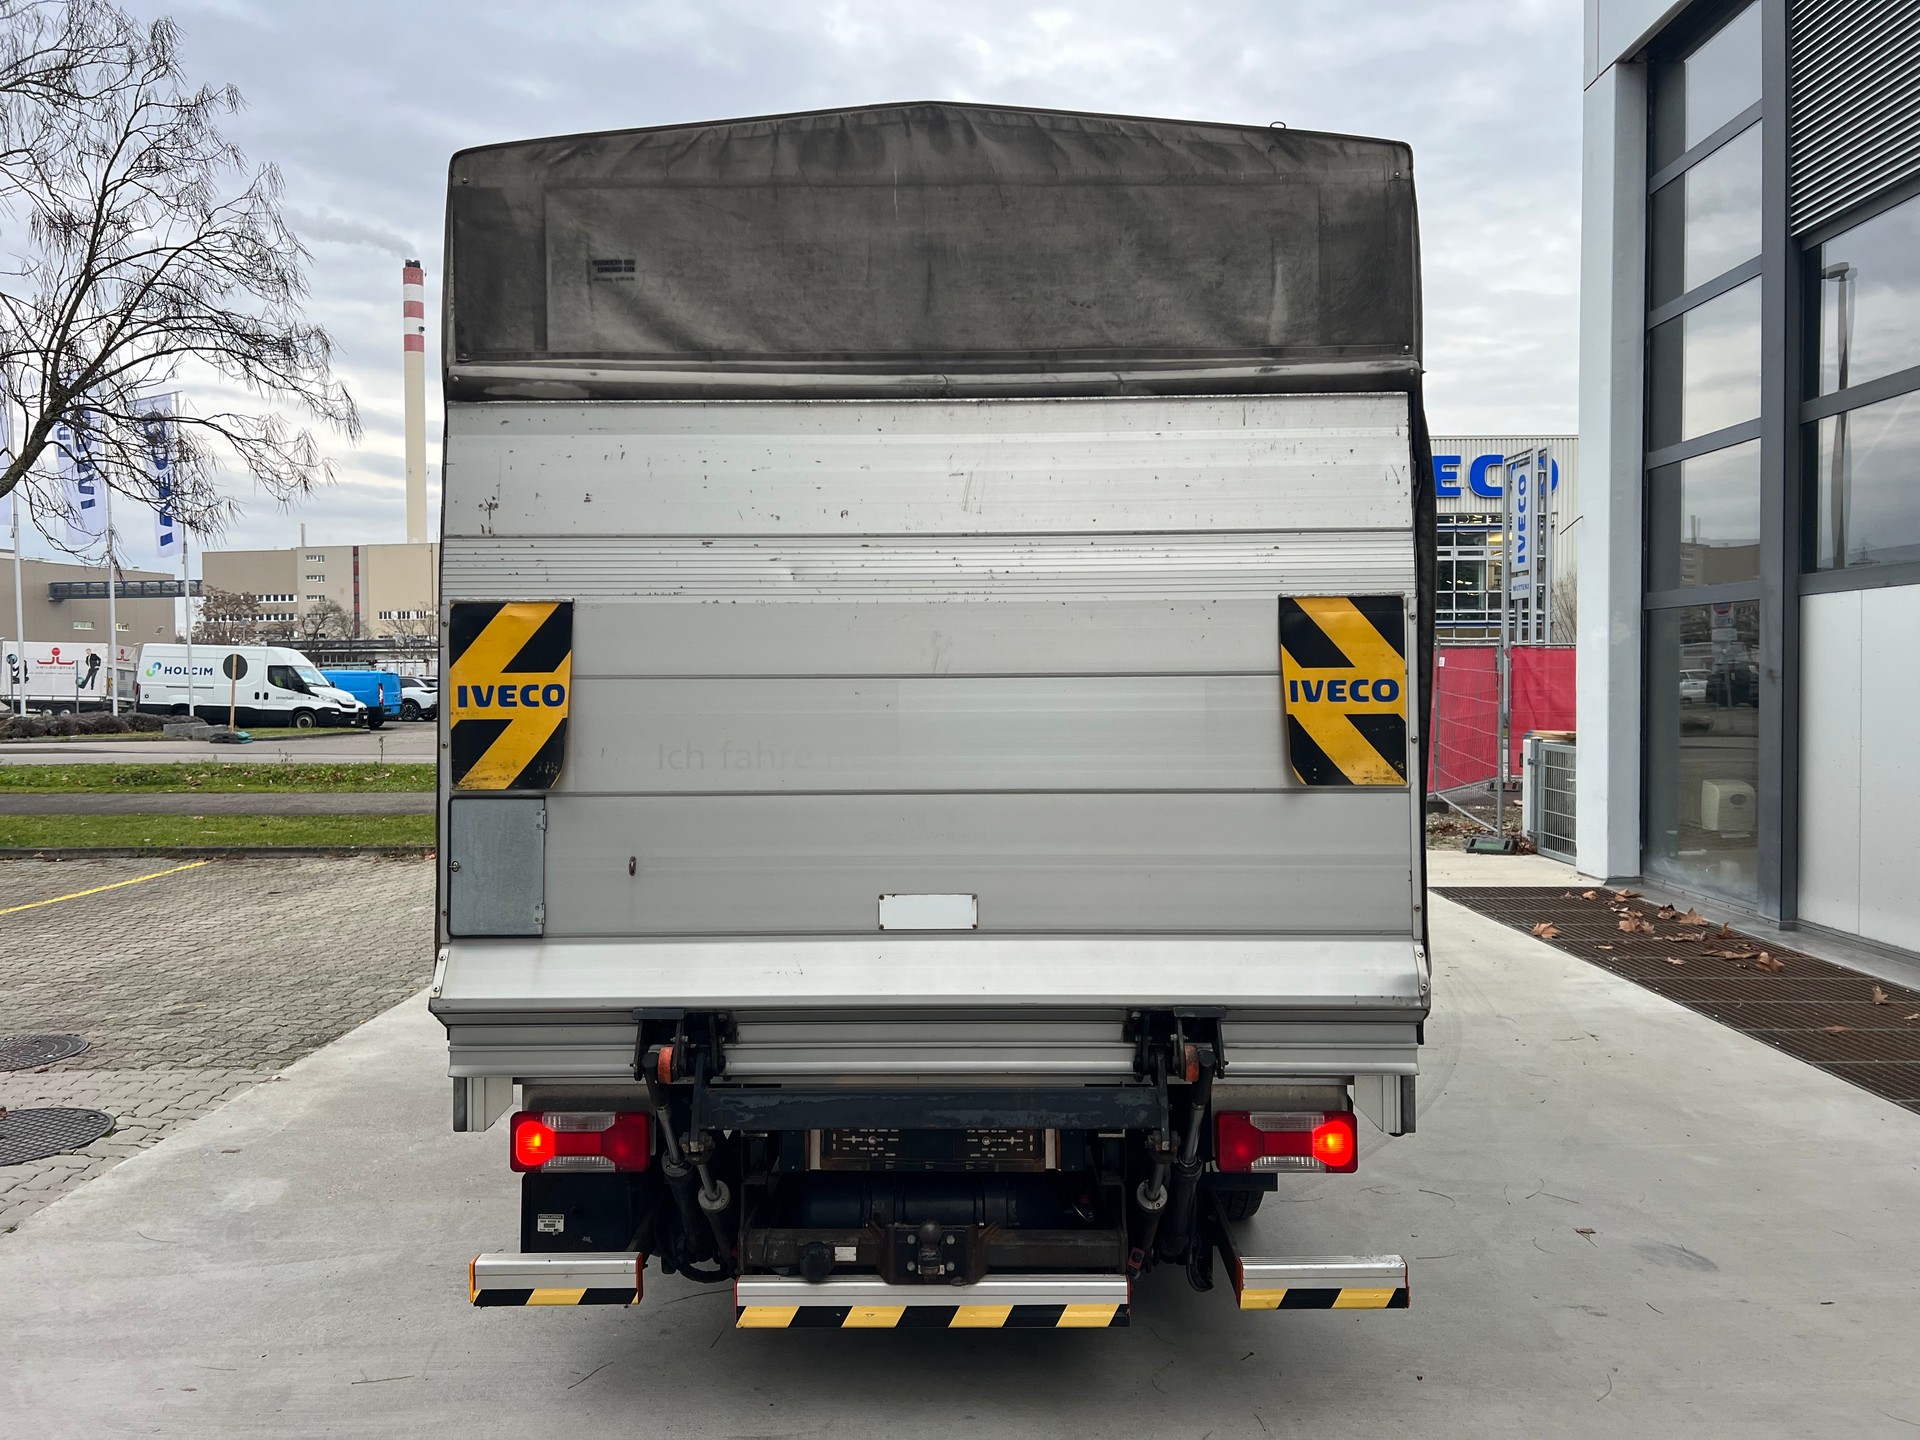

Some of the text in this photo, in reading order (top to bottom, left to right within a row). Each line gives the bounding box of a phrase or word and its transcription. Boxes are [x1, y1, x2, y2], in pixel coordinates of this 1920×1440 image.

[1517, 474, 1528, 564] IVECO
[164, 666, 214, 676] HOLCIM
[457, 684, 566, 708] IVECO
[1289, 679, 1400, 703] IVECO
[658, 741, 704, 771] Ich
[717, 740, 813, 770] fahre
